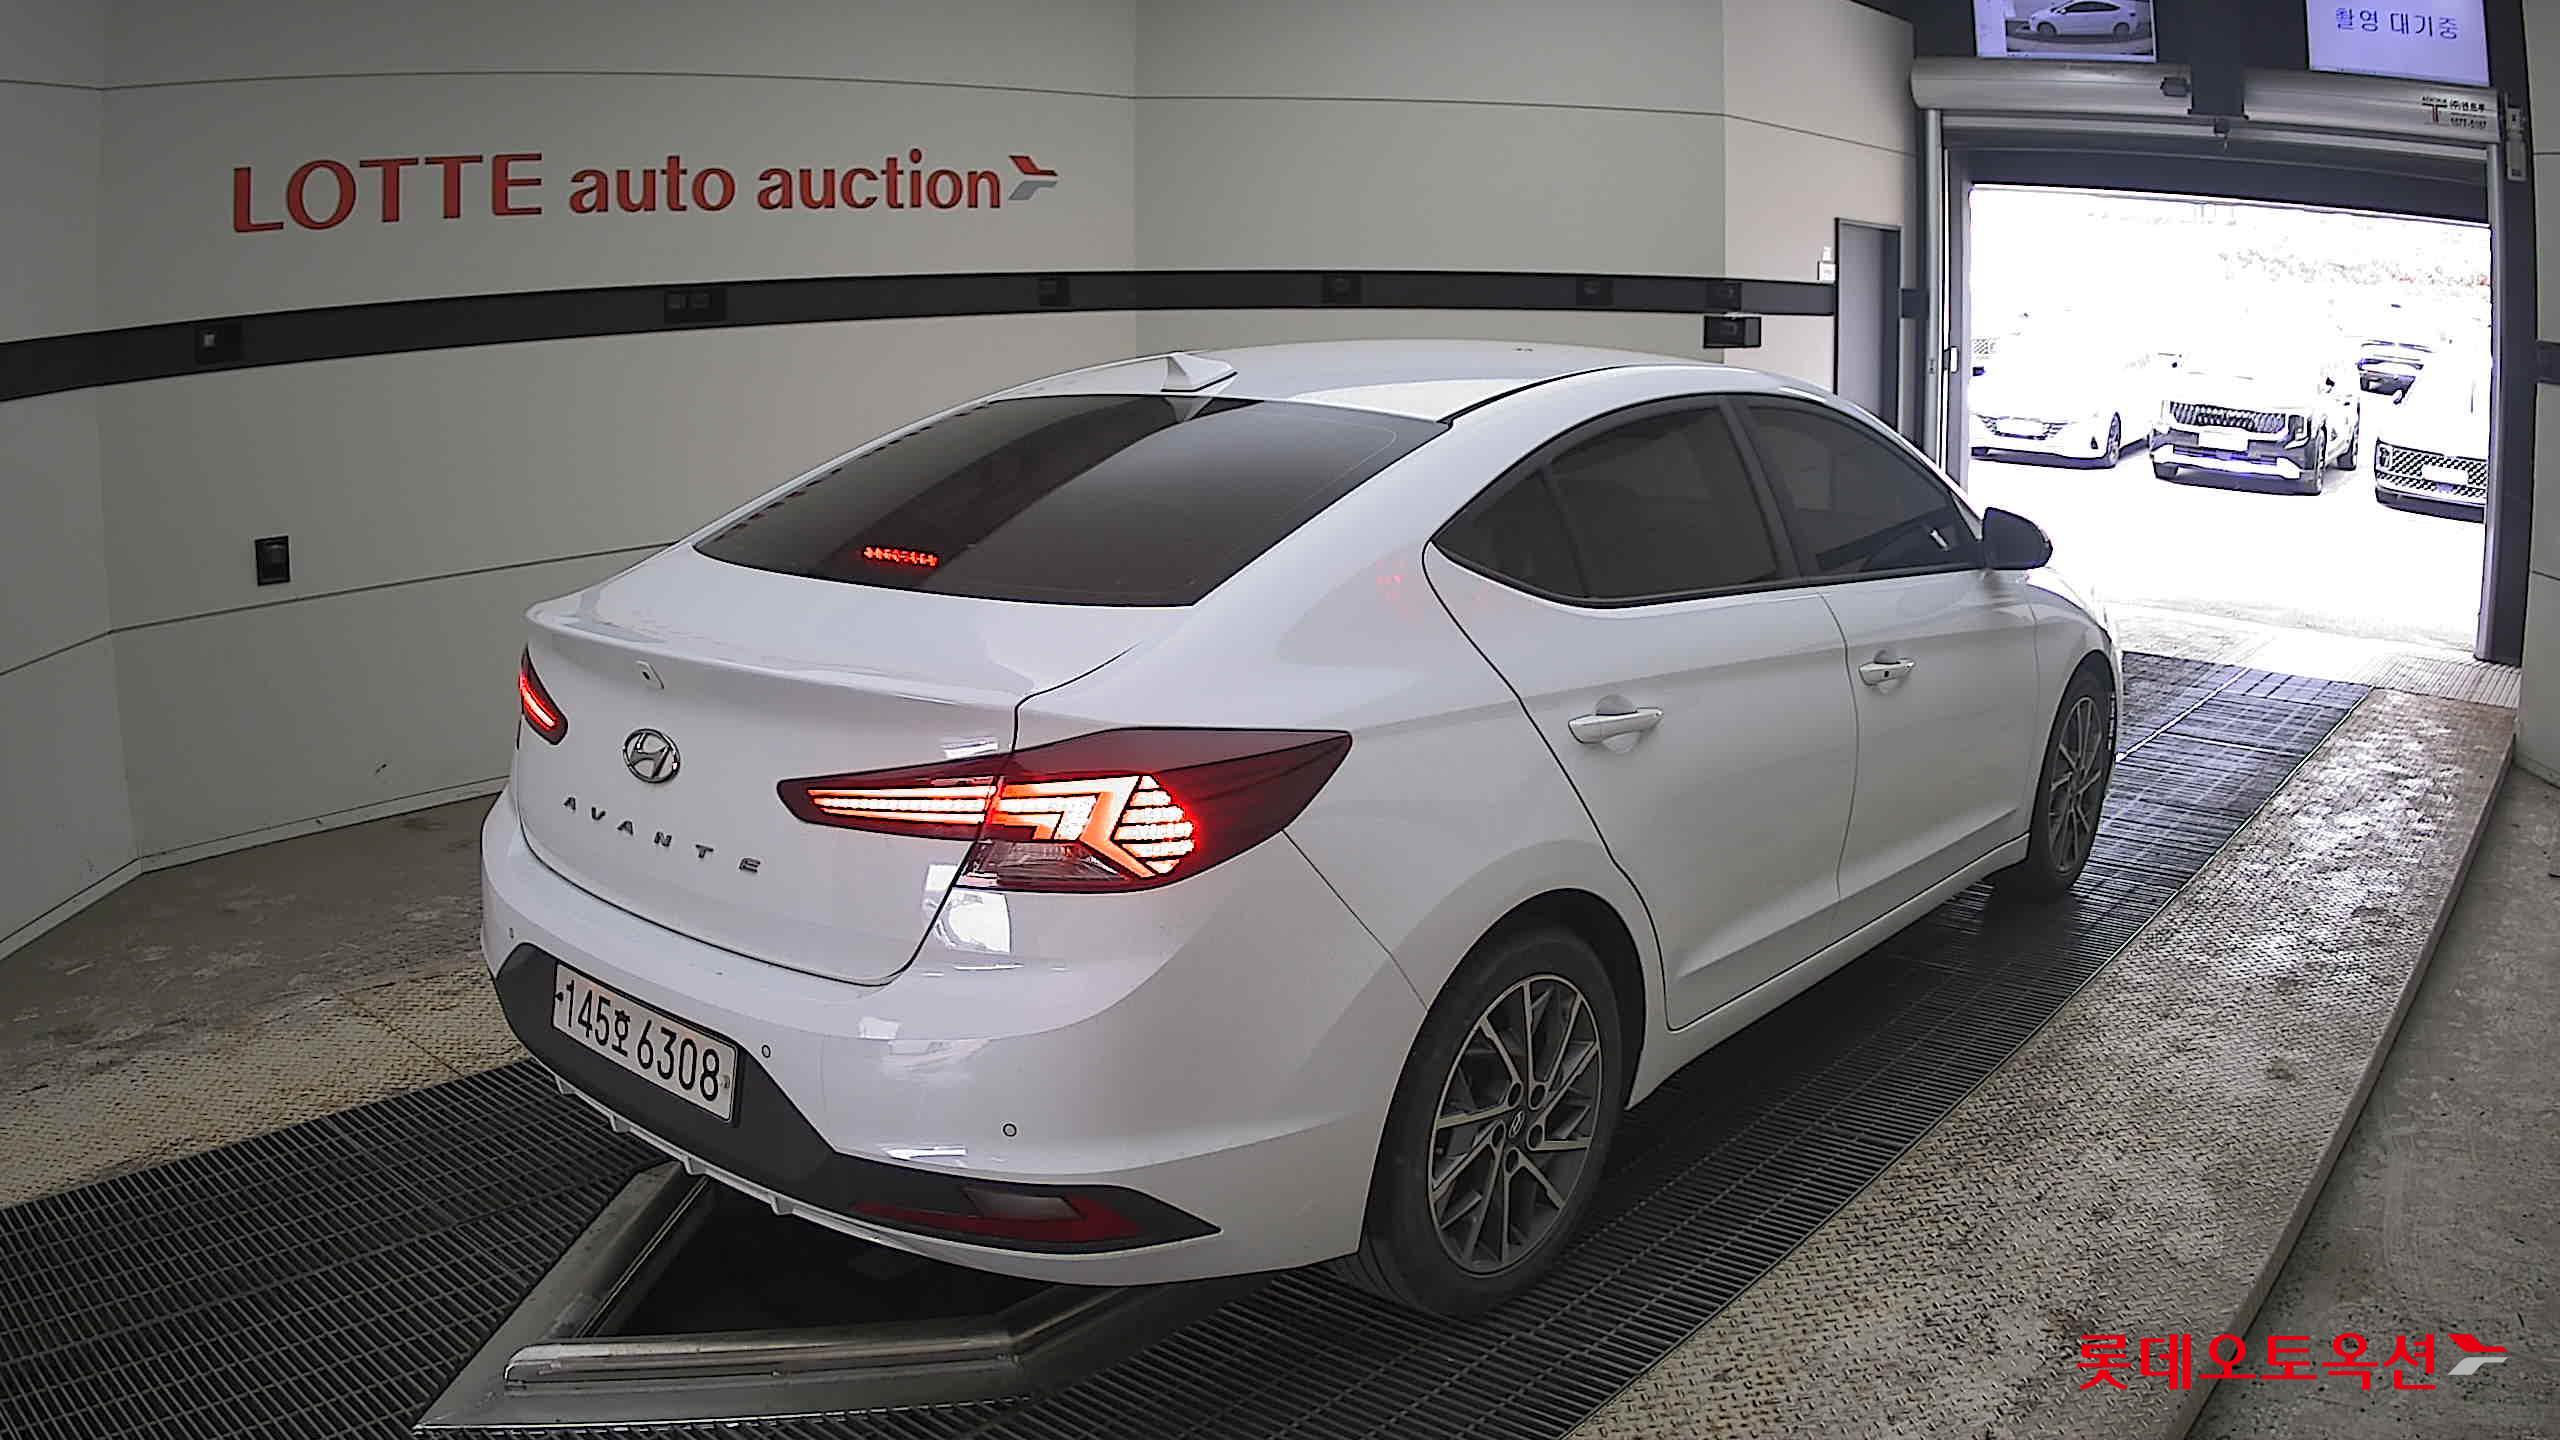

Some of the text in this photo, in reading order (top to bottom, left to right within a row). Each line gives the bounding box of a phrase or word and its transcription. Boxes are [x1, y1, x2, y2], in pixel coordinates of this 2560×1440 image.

[2335, 7, 2458, 39] 촬영 대기중
[232, 148, 1002, 233] LOTTE auto auction
[563, 796, 761, 873] AVANTE
[565, 980, 721, 1103] 145호 6308
